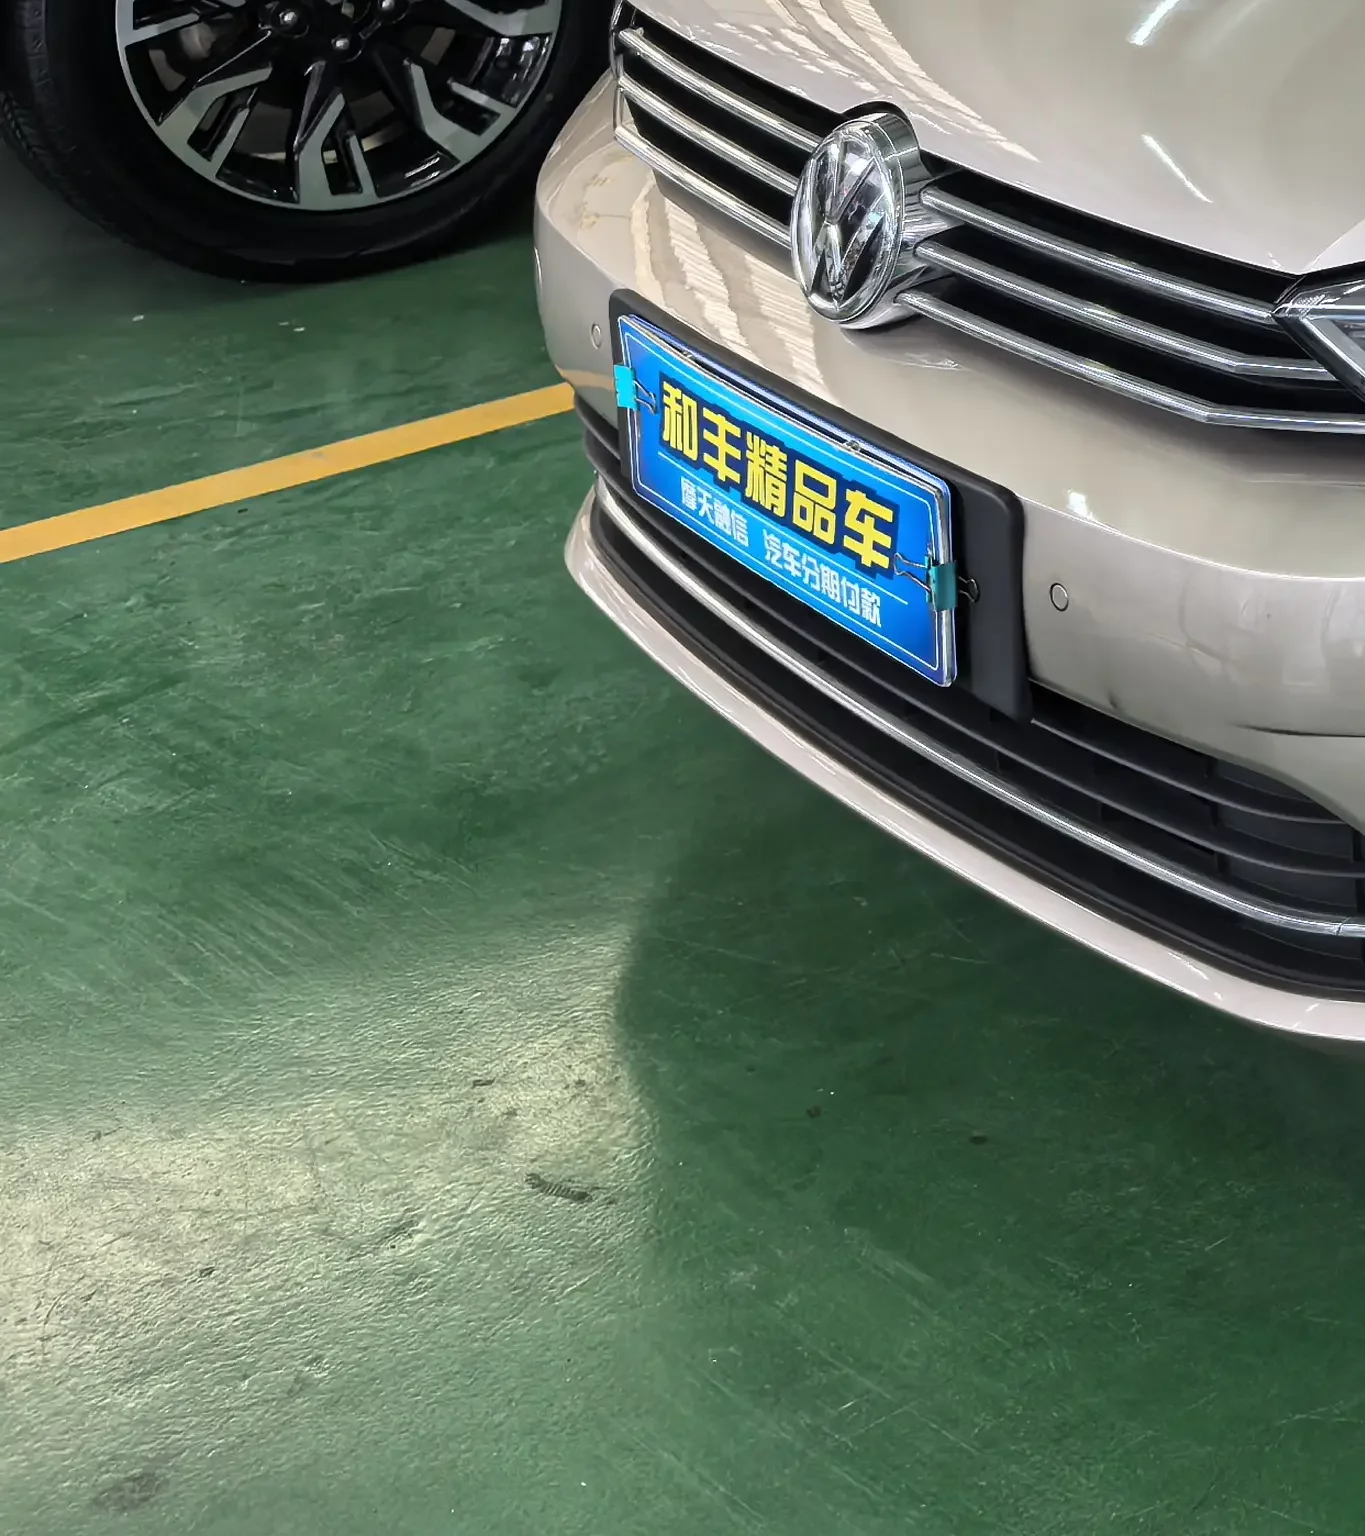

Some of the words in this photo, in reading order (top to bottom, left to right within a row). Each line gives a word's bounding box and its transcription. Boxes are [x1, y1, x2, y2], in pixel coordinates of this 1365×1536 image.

[662, 380, 894, 570] 和丰精品车
[763, 529, 882, 628] 汽车分期付款
